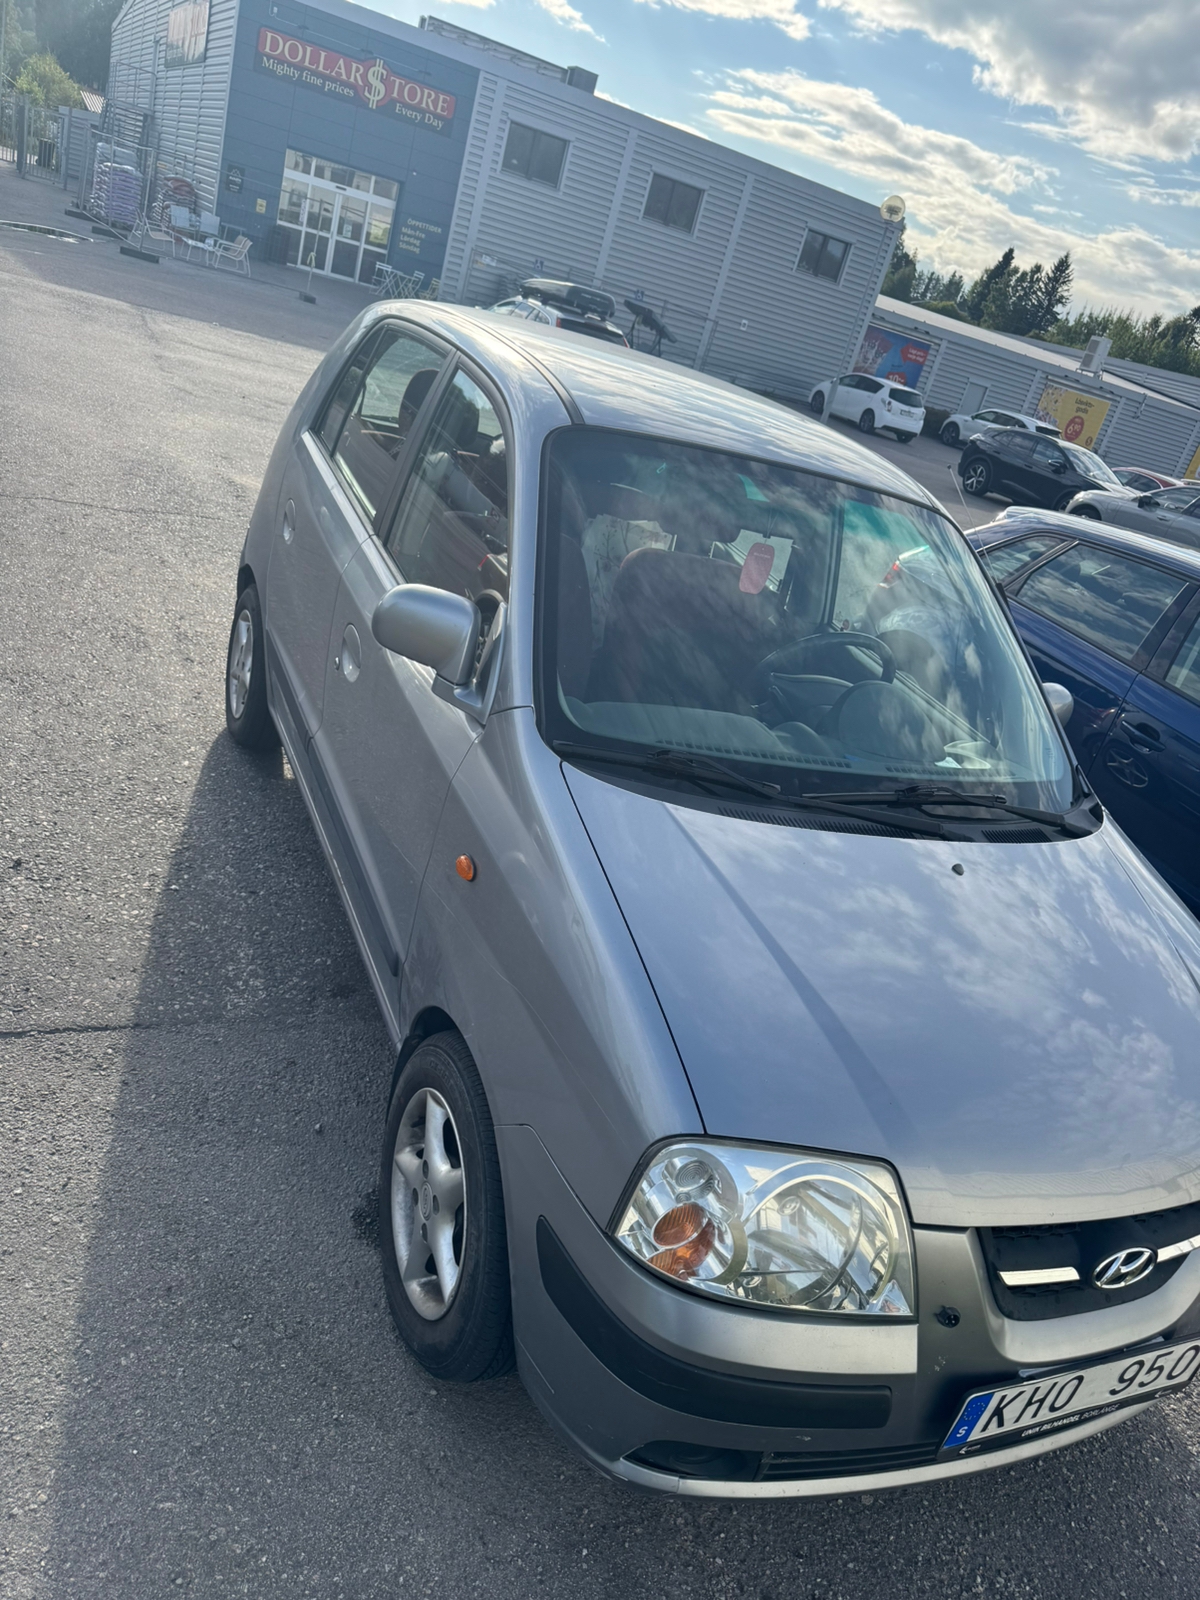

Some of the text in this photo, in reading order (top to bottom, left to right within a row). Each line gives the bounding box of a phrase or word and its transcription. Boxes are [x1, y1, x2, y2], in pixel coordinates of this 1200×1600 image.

[262, 56, 355, 97] Mighty fine prices
[395, 103, 444, 130] Every Day
[407, 218, 442, 234] ÖPPETTIDER
[399, 241, 420, 254] Söndag
[400, 234, 420, 246] Lördag
[1075, 406, 1089, 414] godis
[980, 1344, 1200, 1433] KHO 950
[956, 1426, 968, 1437] S
[1022, 1425, 1041, 1437] UNIK
[1041, 1415, 1080, 1431] BILHANDEL
